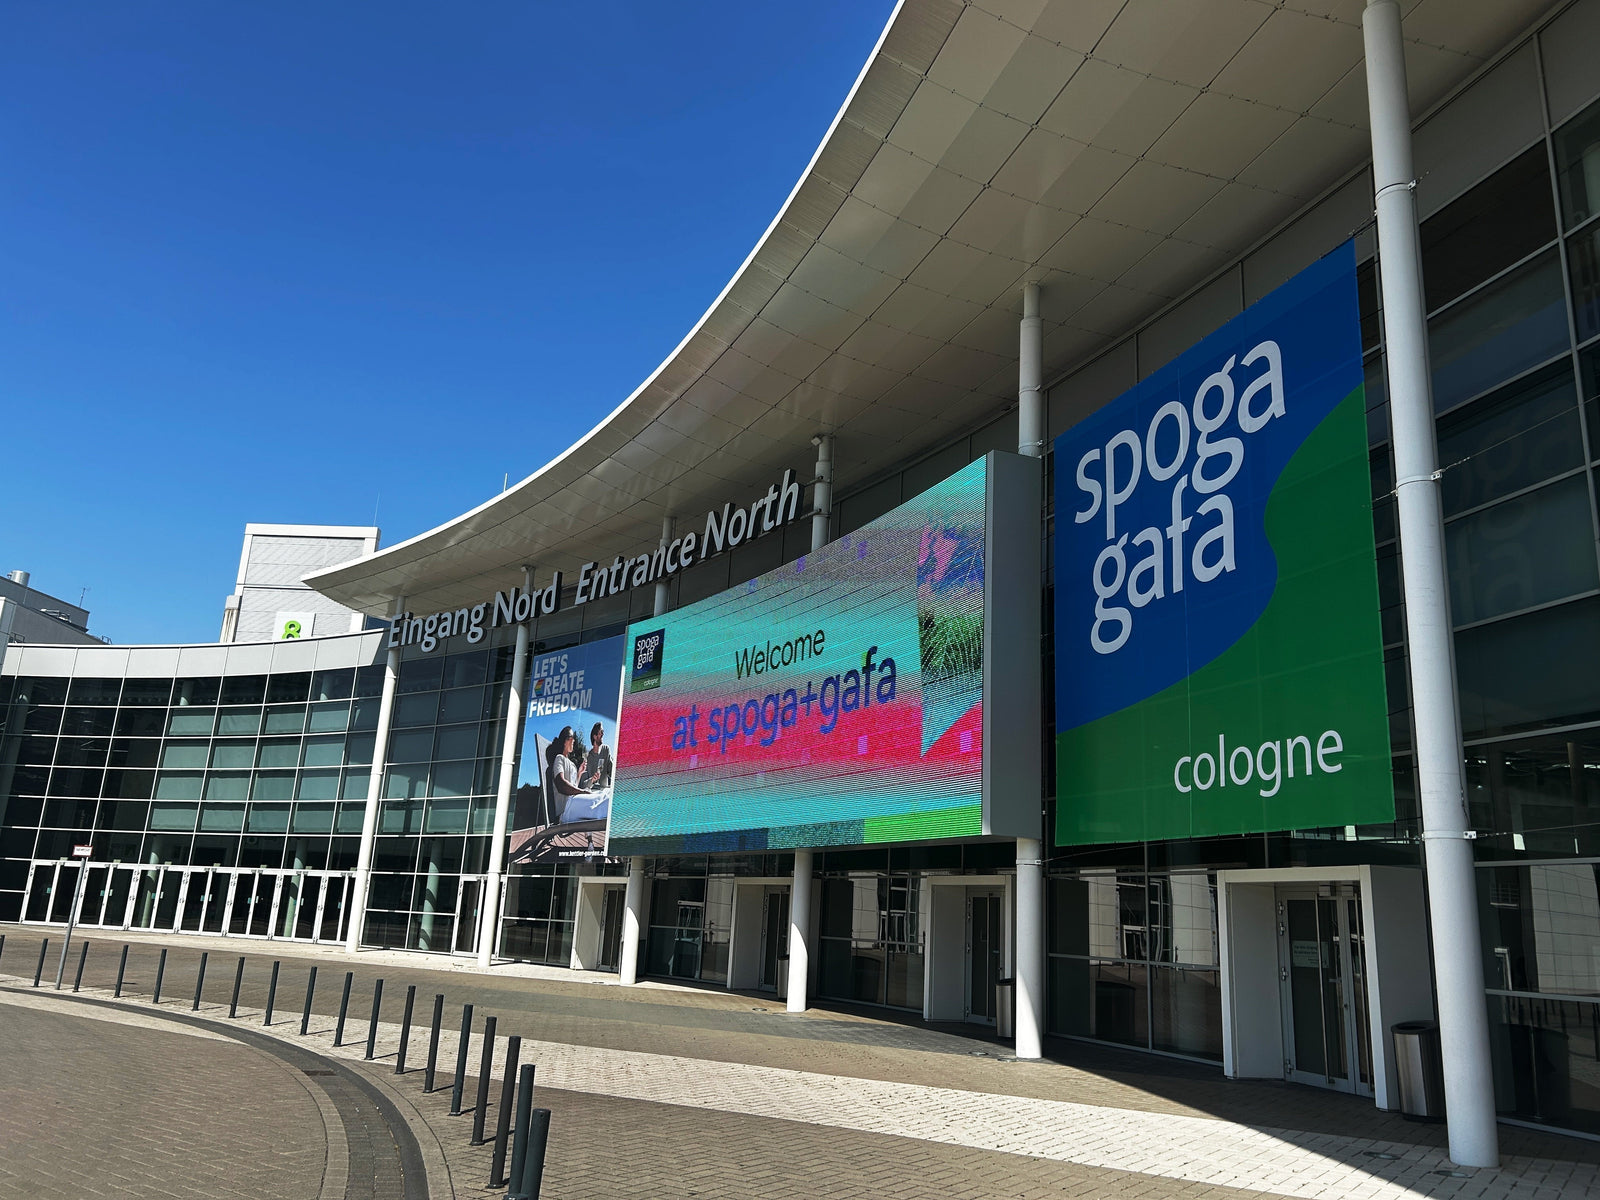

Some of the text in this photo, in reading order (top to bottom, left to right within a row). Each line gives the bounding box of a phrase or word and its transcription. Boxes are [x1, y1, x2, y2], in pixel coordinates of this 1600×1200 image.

[1074, 339, 1287, 540] spoga
[387, 468, 800, 653] Eingang Nord Entrance North
[1090, 473, 1237, 655] gafa
[282, 620, 301, 639] 8
[637, 635, 660, 654] spoga
[735, 628, 825, 681] Welcome
[534, 654, 568, 678] LET'S
[637, 648, 654, 669] gafa
[529, 689, 592, 718] FREEDOM
[671, 646, 897, 754] at spoga+gafa
[1174, 730, 1344, 798] cologne
